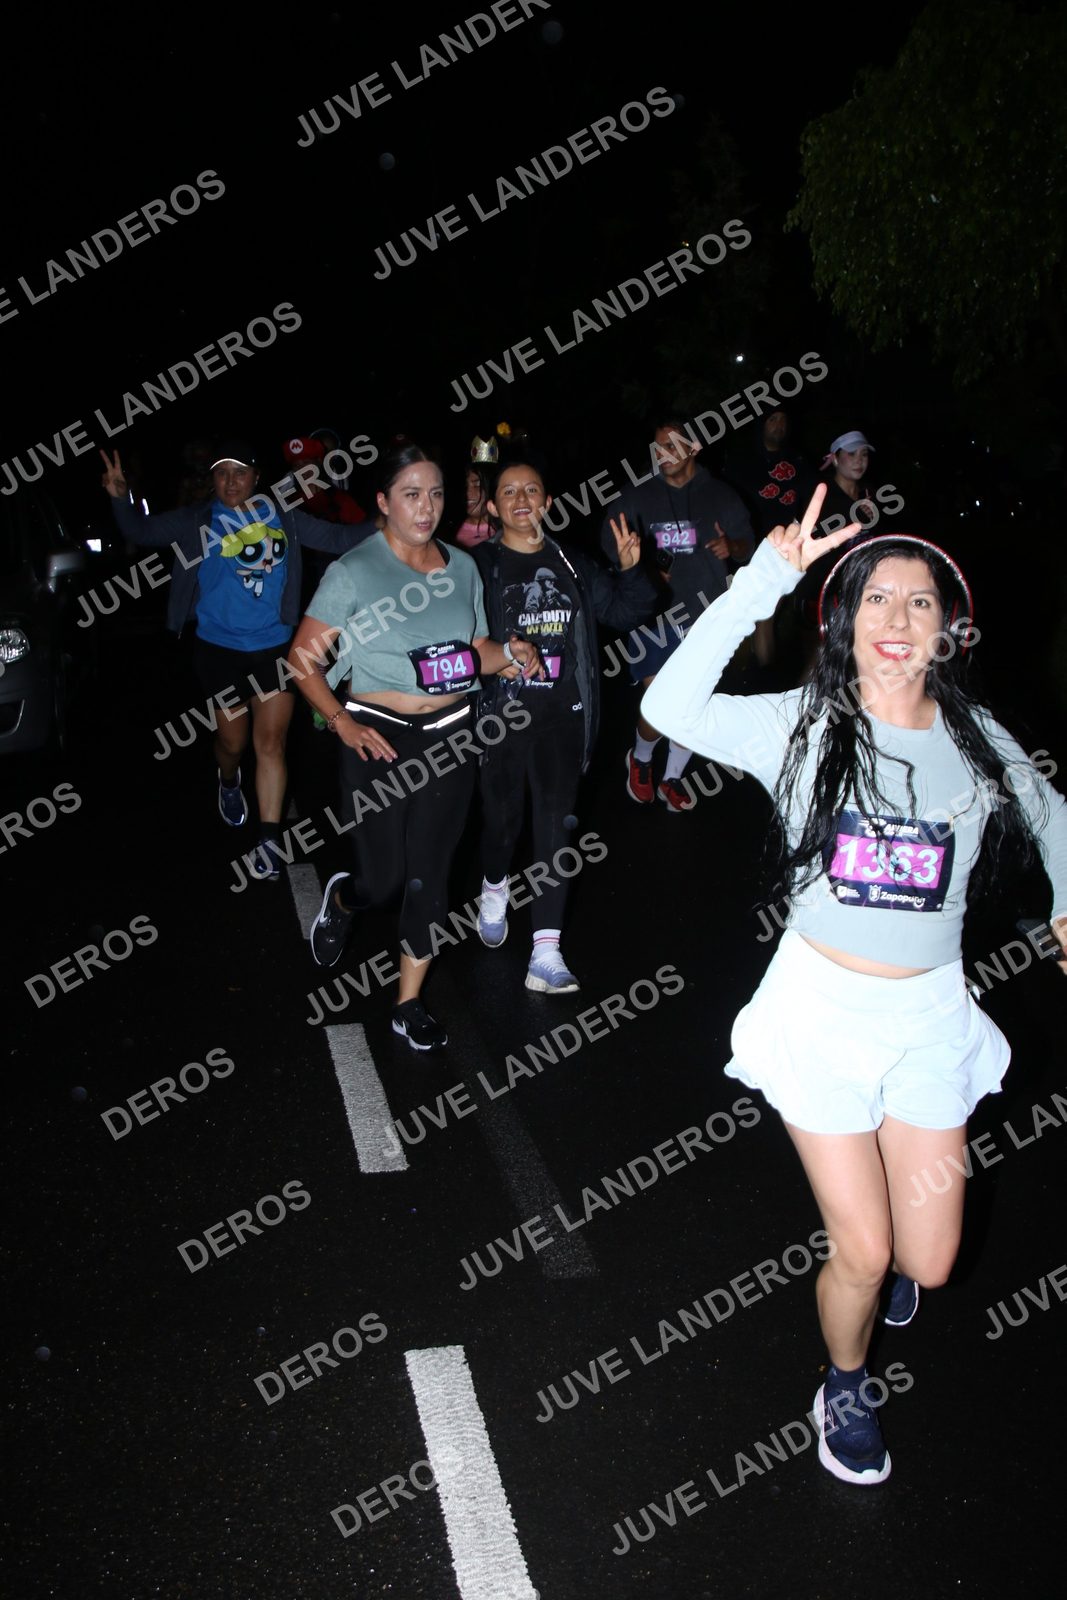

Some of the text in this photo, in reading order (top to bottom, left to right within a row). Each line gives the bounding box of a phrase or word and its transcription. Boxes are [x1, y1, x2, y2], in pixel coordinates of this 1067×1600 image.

[662, 530, 690, 547] 942
[542, 609, 572, 623] DUTY
[427, 655, 467, 681] 794
[839, 838, 939, 885] 1363
